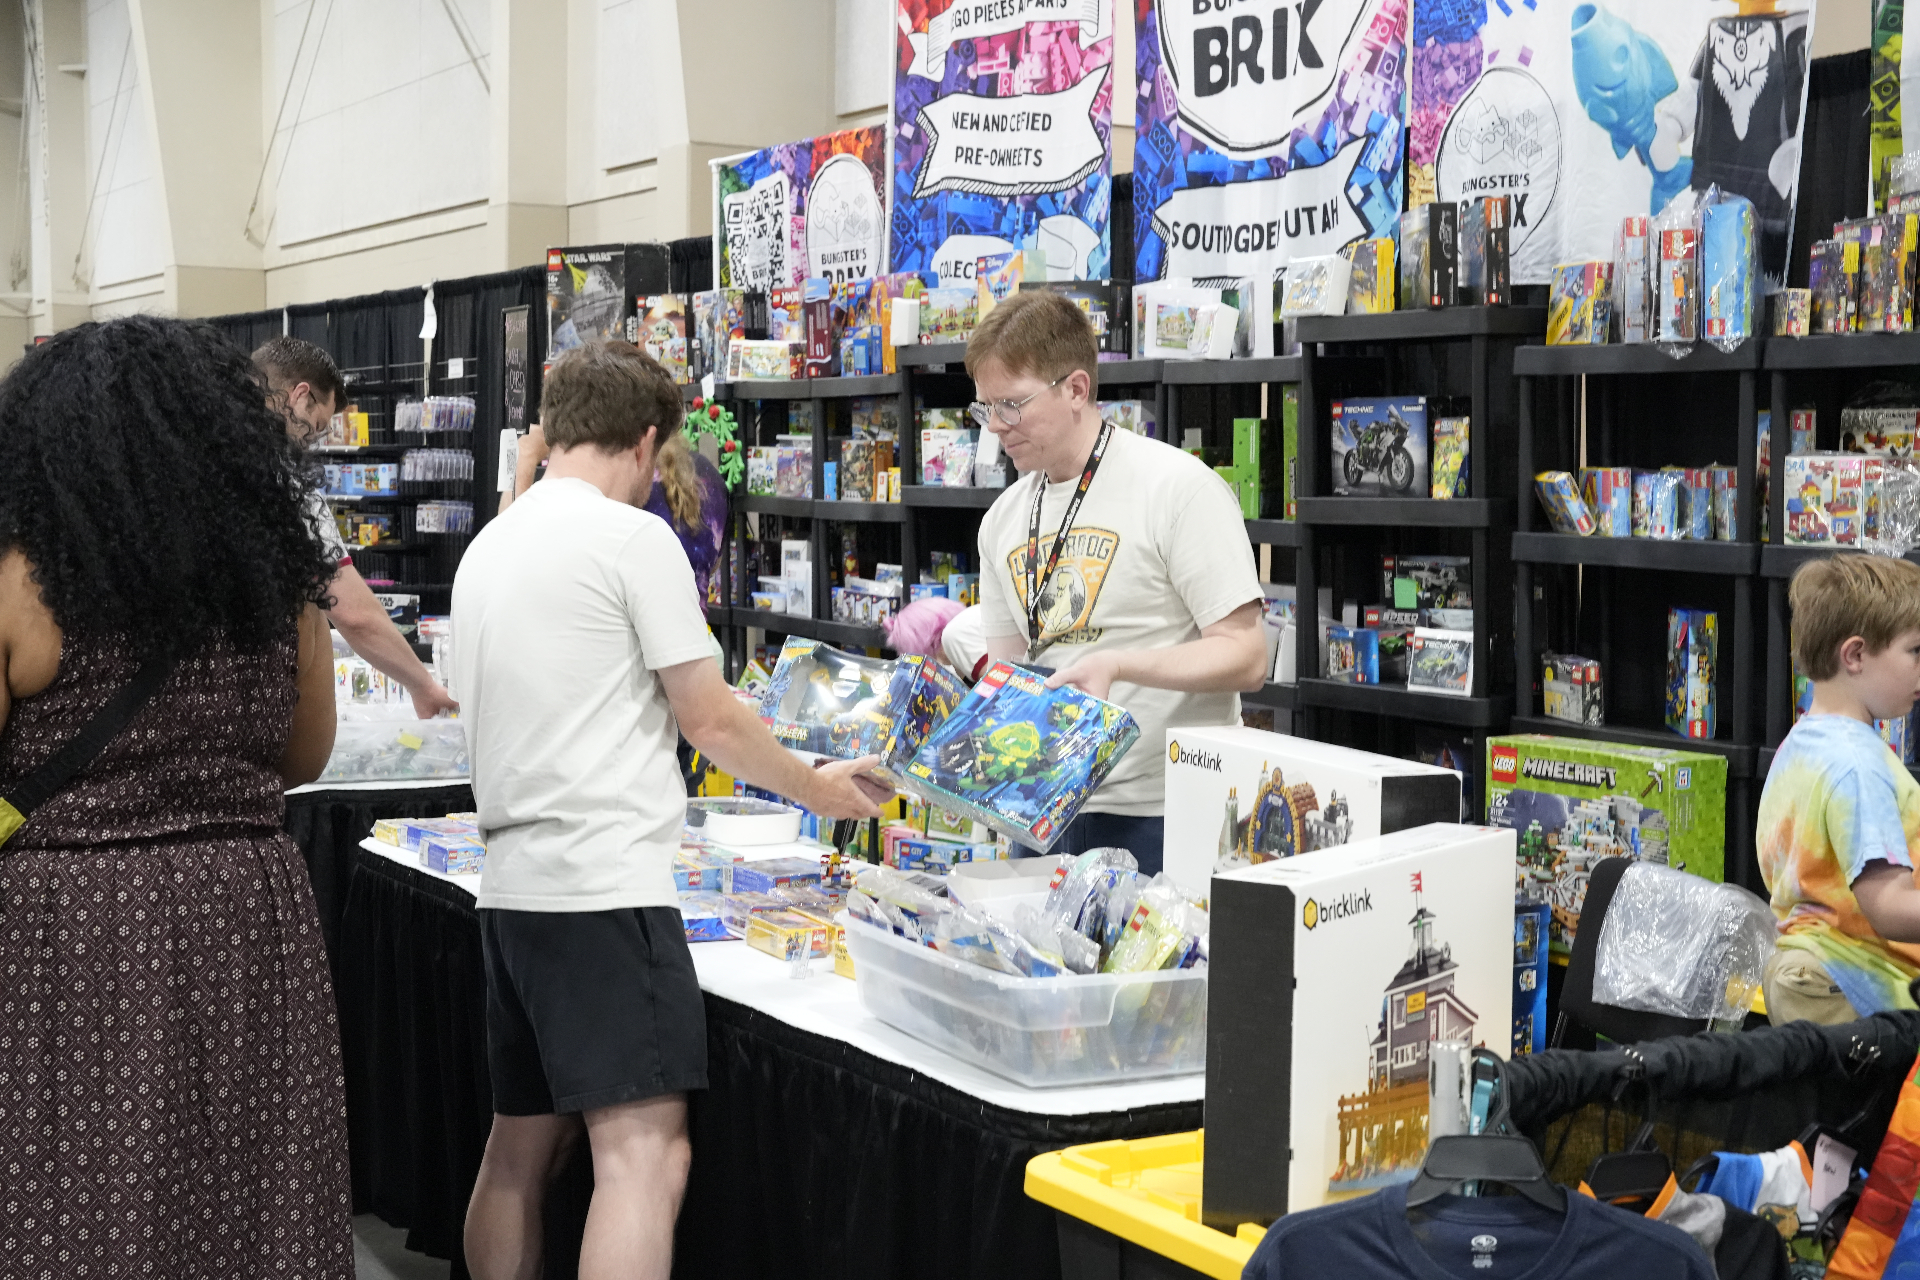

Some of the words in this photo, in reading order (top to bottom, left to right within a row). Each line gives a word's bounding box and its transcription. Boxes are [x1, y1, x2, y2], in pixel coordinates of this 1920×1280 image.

[974, 0, 1015, 24] PIECES
[952, 111, 980, 131] NEW
[983, 114, 1008, 132] AND
[1284, 195, 1340, 238] UTAH
[588, 251, 612, 262] WARS
[1344, 405, 1374, 415] TECHNIC
[1007, 674, 1046, 696] SYSTEM
[772, 723, 809, 741] SYSTEM
[1180, 748, 1222, 773] bricklink
[1493, 756, 1516, 773] LEGO
[1522, 757, 1617, 789] MINECRAFT
[1491, 792, 1508, 808] 12+
[1037, 820, 1050, 838] LEGO
[1049, 789, 1076, 822] SYSTEM
[911, 847, 923, 856] CITY
[1319, 888, 1374, 924] bricklink
